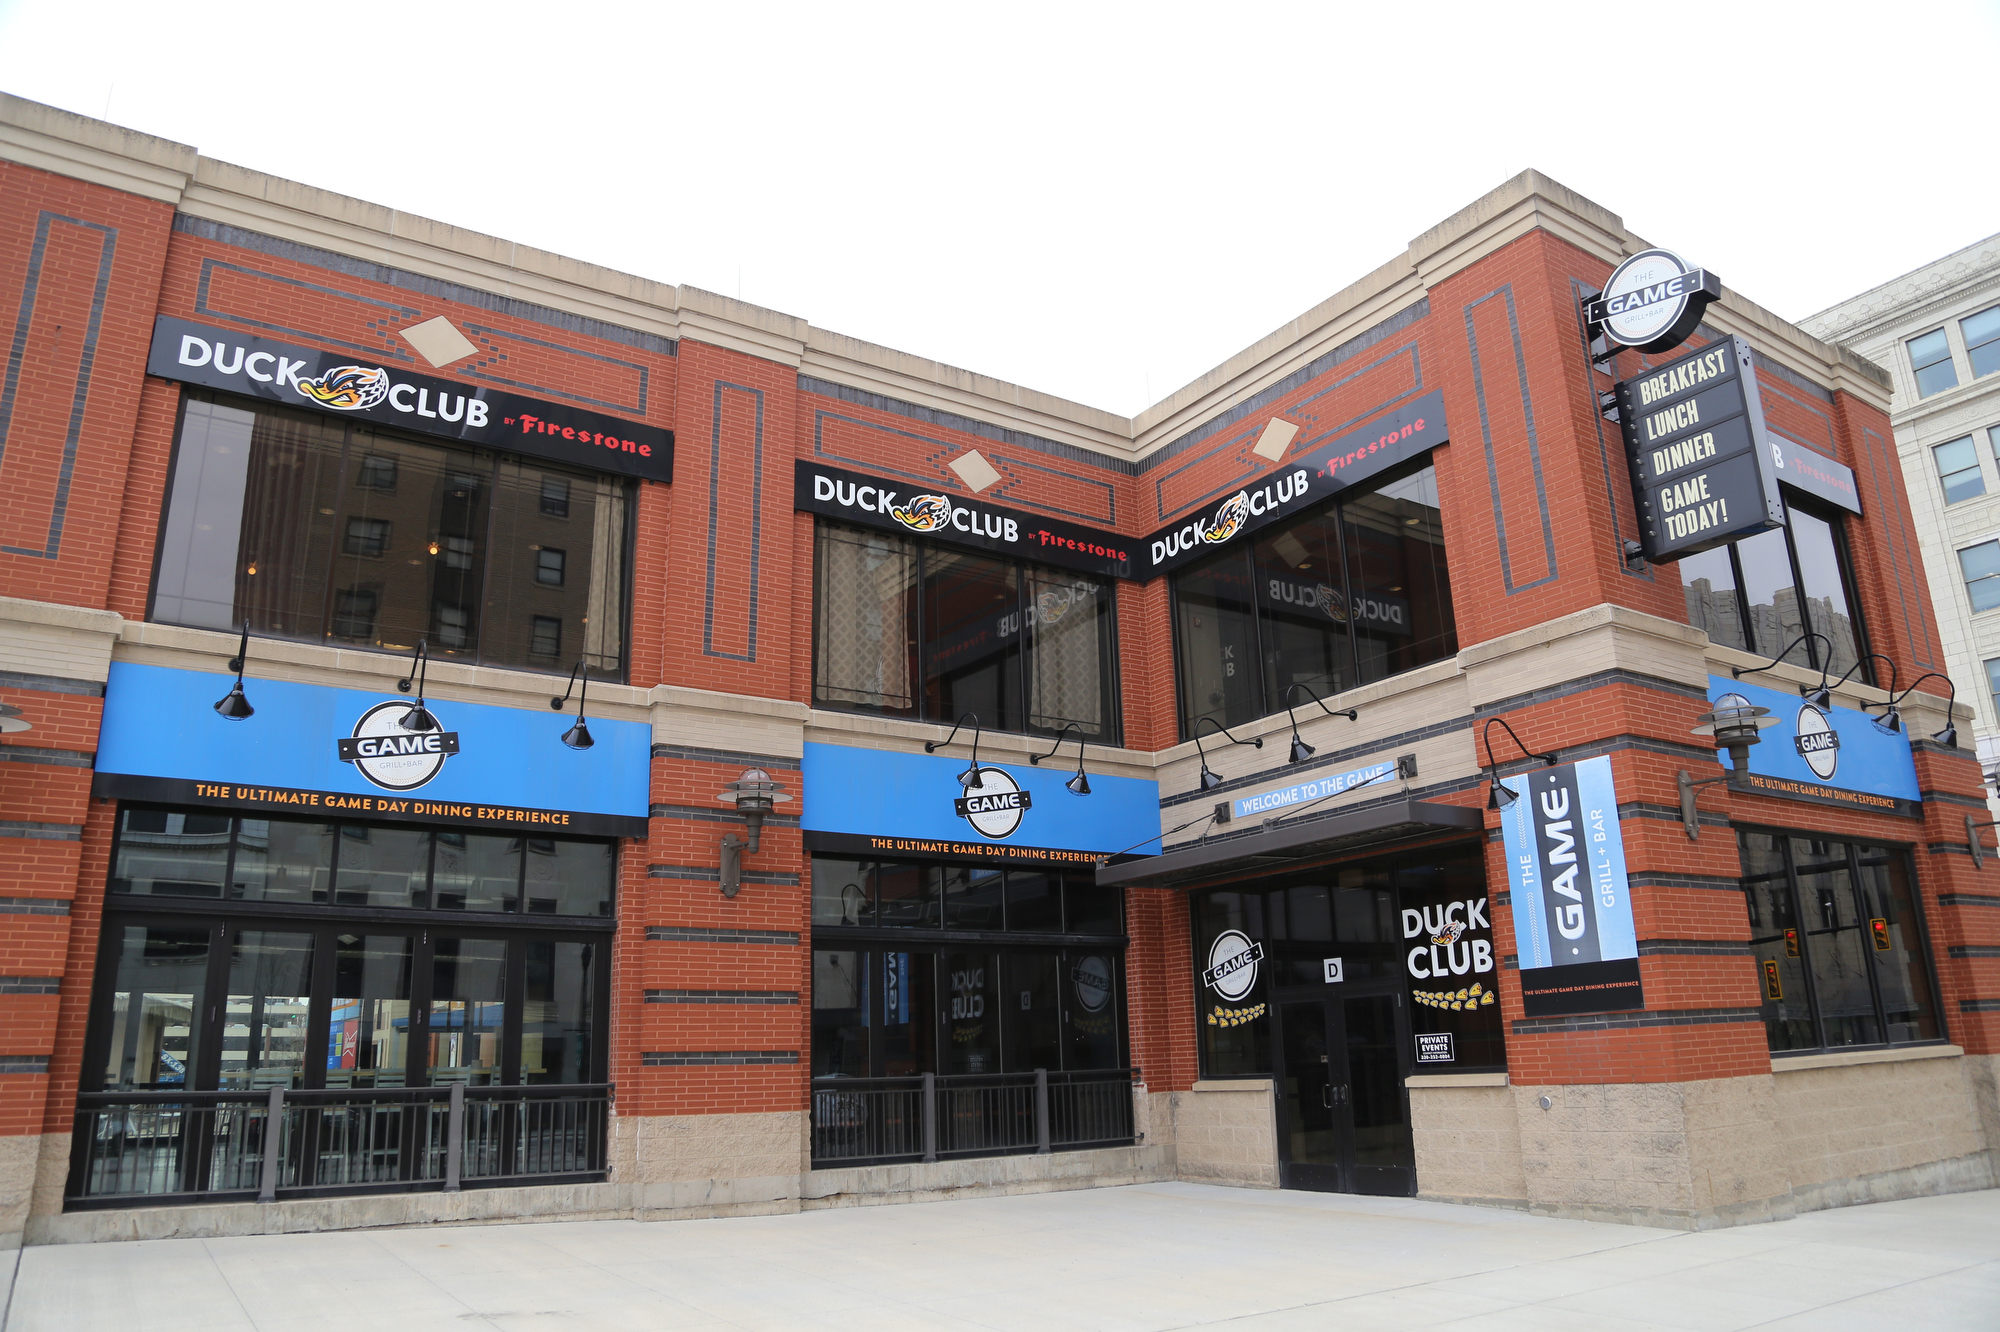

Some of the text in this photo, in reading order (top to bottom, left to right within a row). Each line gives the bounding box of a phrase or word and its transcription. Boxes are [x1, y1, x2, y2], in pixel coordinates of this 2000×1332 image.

[1634, 270, 1654, 283] THE
[1607, 278, 1683, 315] GAME
[1624, 307, 1664, 324] GRILL+BAR
[1639, 348, 1726, 406] BREAKFAST
[178, 334, 652, 457] DUCK CLUB BY Firestone
[1645, 399, 1700, 441] LUNCH
[1652, 432, 1717, 476] DINNER
[1151, 418, 1426, 565] DUCK CLUB BY Firestone
[1794, 457, 1853, 494] Firestone
[1660, 474, 1711, 513] GAME
[814, 475, 1127, 561] DUCK CLUB BY Firestone
[1664, 498, 1729, 541] TODAY!
[386, 721, 400, 731] TH
[1807, 720, 1817, 729] THE
[357, 734, 442, 757] GAME
[1801, 732, 1834, 751] GAME
[379, 760, 423, 769] GRILL+BAR
[966, 793, 1021, 813] GAME
[984, 783, 998, 791] THE
[1242, 766, 1384, 813] WELCOME TO THE GAME
[1749, 776, 1895, 809] THE ULTIMATE GAME DAY DINING EXPERIENCE
[196, 784, 570, 825] THE ULTIMATE GAME DAY DINING EXPERIENCE
[1590, 808, 1607, 843] BAR
[871, 838, 893, 849] THE
[896, 840, 949, 853] ULTIMATE
[952, 844, 982, 855] GAME
[986, 846, 1006, 856] DAY
[1009, 848, 1047, 860] DINING
[1540, 787, 1586, 940] GAME
[1519, 854, 1535, 887] THE
[1598, 858, 1616, 908] GRILL
[1223, 945, 1235, 956] THE
[1401, 897, 1494, 980] DUCK CLUB
[1213, 949, 1253, 980] GAME
[1328, 963, 1338, 978] D
[1605, 981, 1639, 989] EXPERIENCE
[1420, 1036, 1448, 1044] PRIVATE
